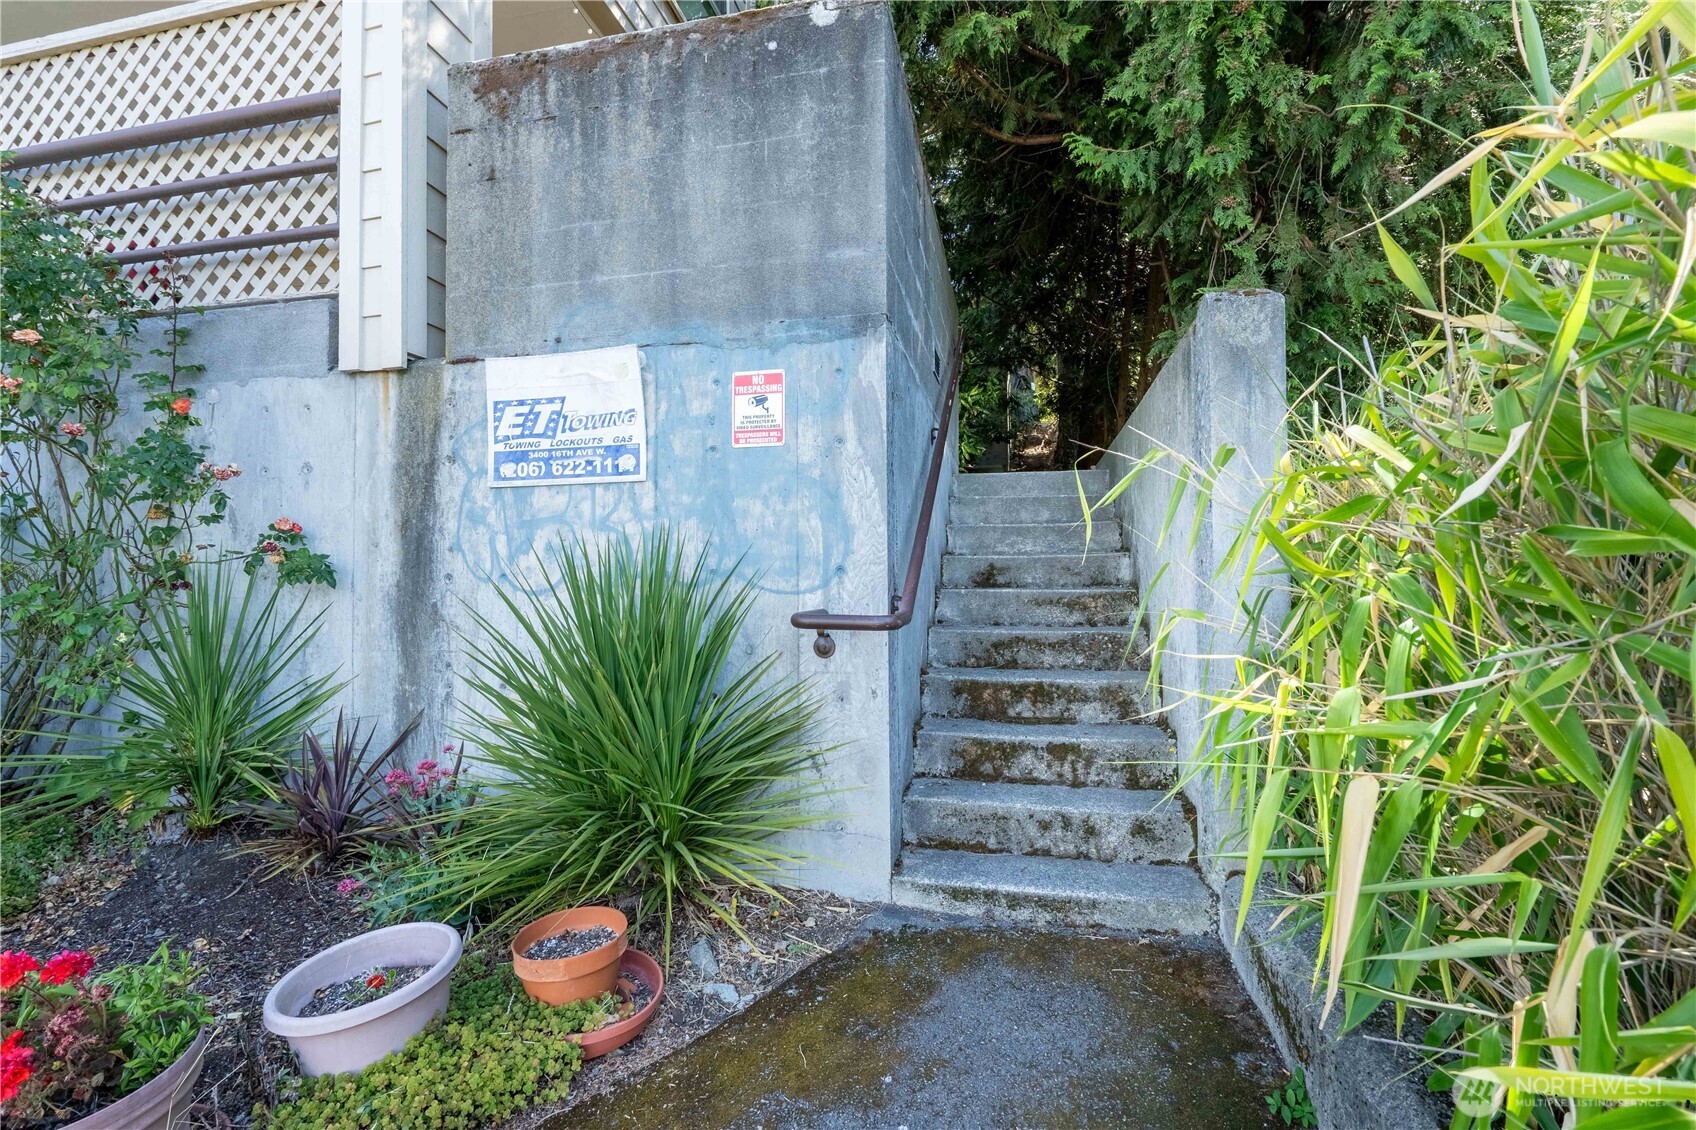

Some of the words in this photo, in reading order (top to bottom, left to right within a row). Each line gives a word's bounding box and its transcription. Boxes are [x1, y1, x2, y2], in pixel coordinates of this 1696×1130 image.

[752, 375, 764, 384] NO
[735, 384, 782, 394] TRESPASSING
[496, 403, 562, 436] ET
[503, 441, 541, 450] TOWING
[550, 437, 604, 448] LOCKOUTS
[613, 435, 633, 444] GAS
[528, 451, 548, 459] 3400
[551, 450, 574, 458] 16TH
